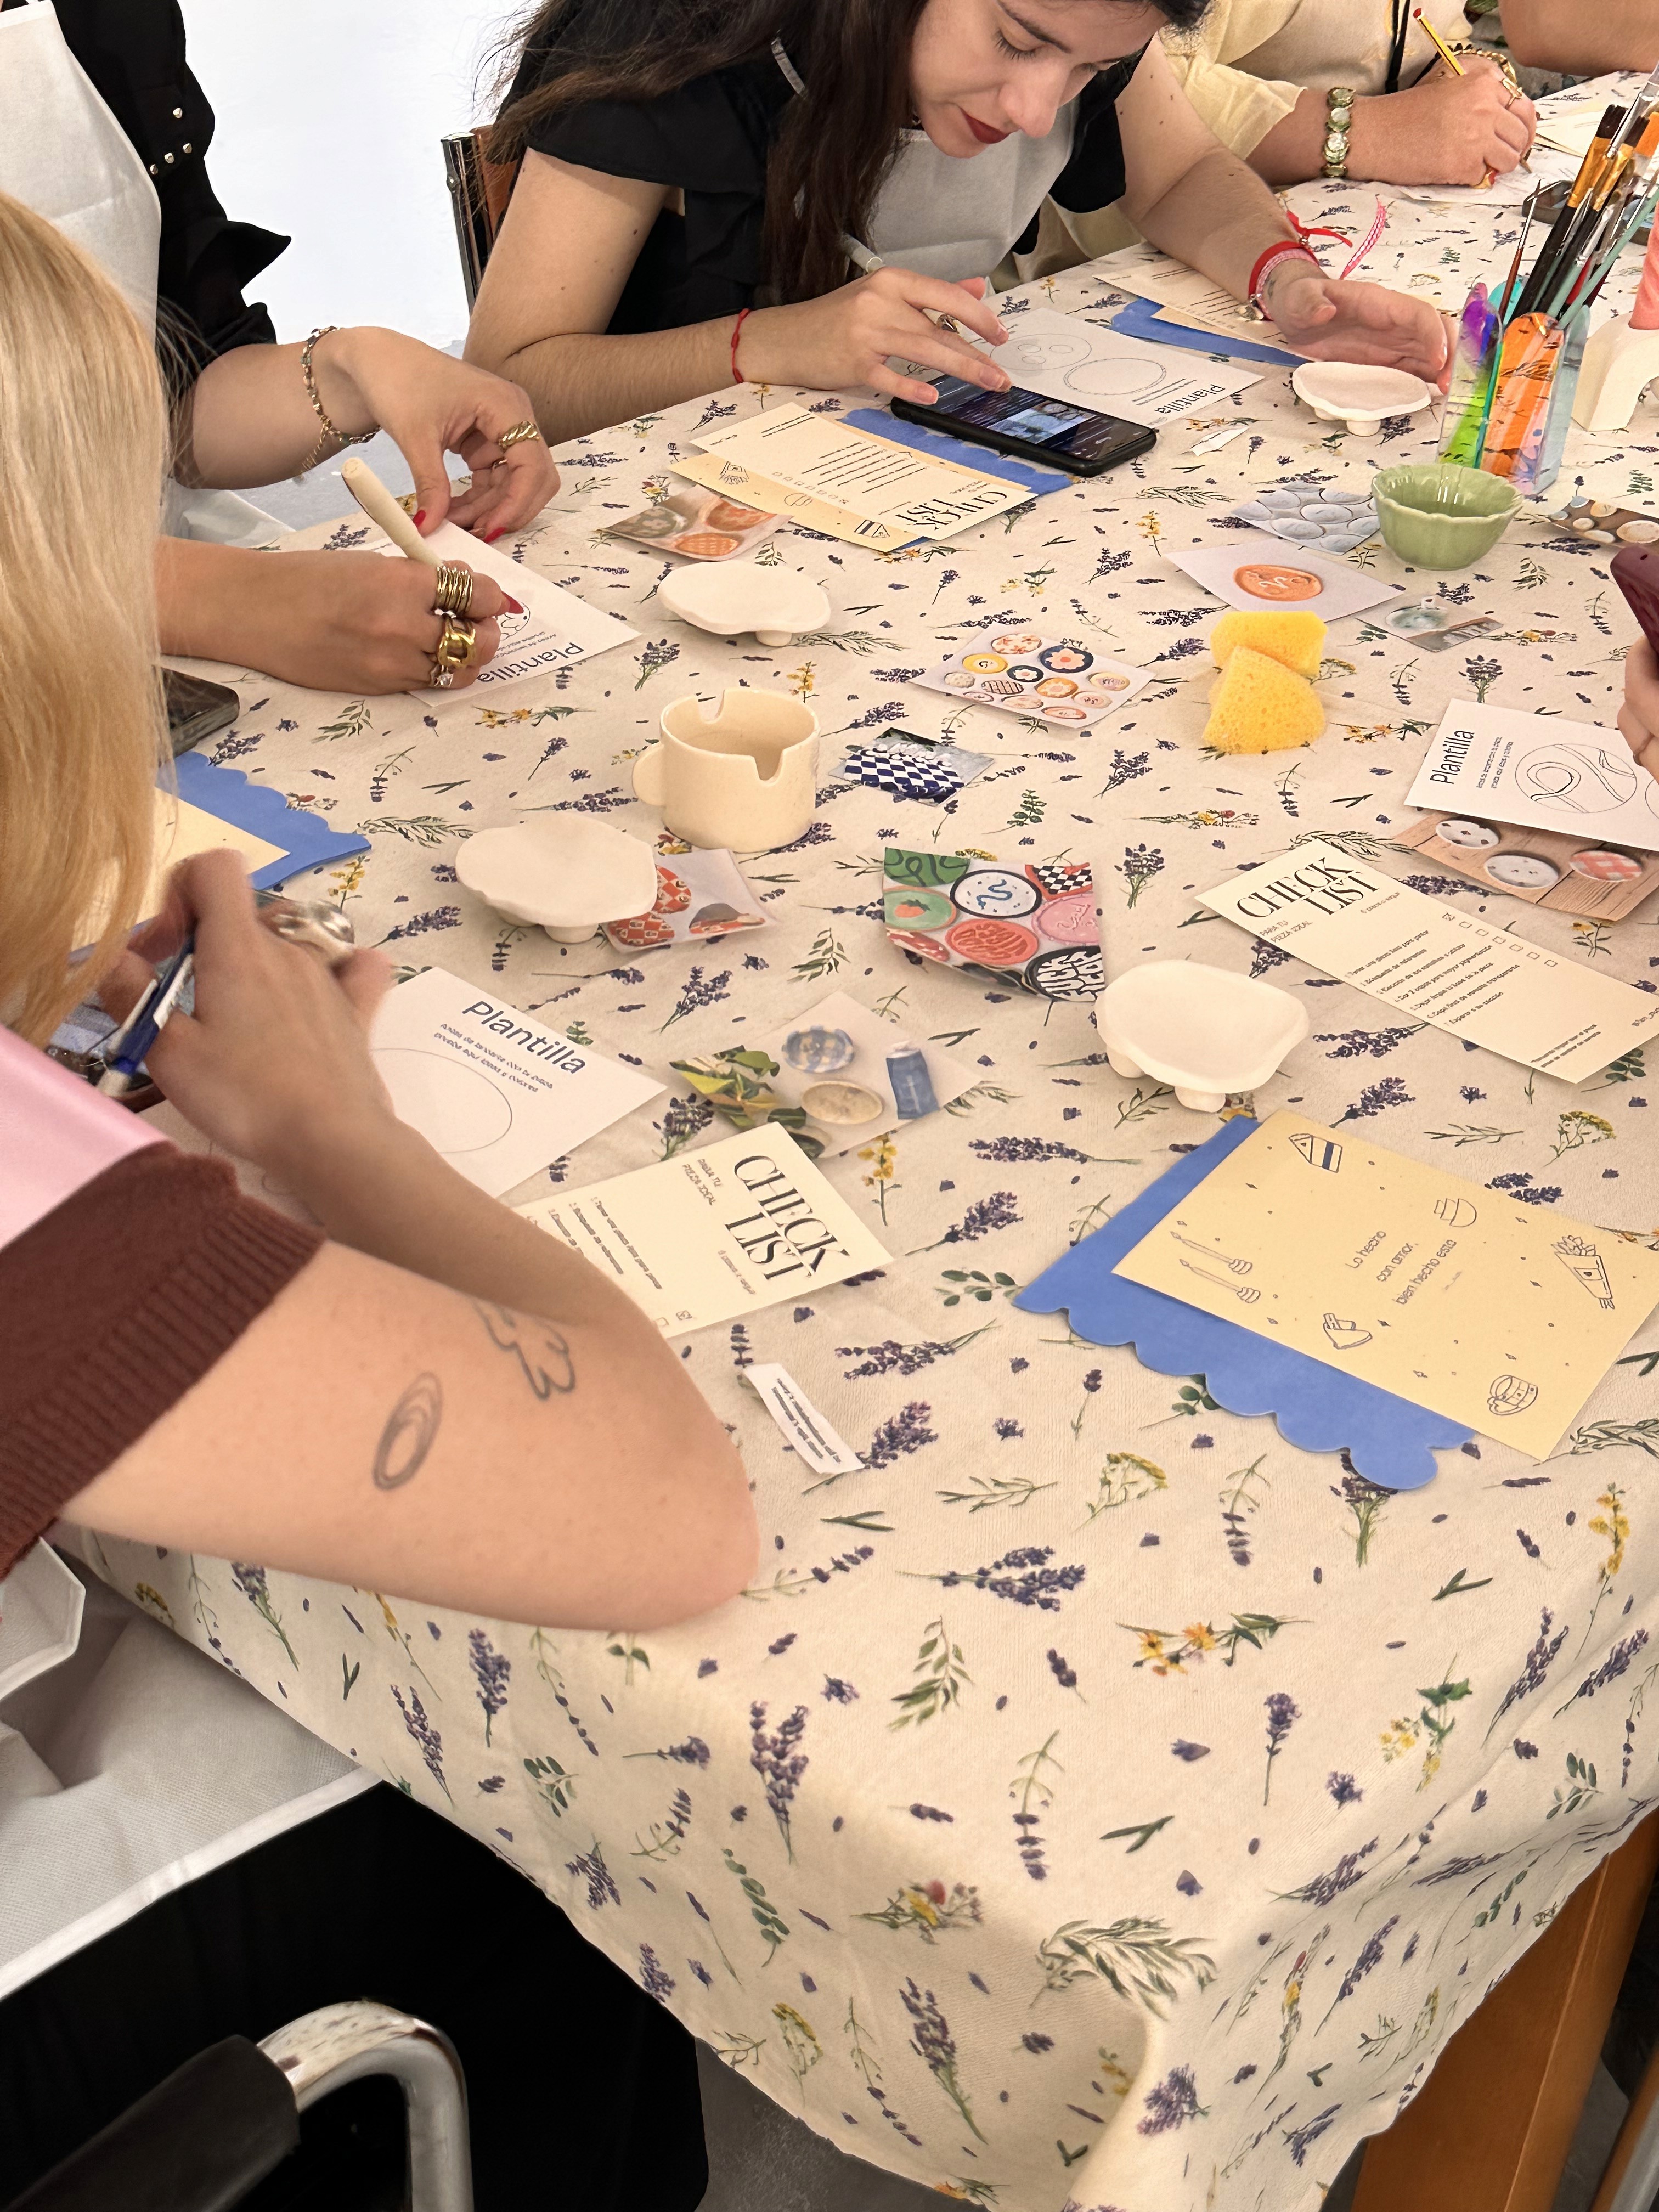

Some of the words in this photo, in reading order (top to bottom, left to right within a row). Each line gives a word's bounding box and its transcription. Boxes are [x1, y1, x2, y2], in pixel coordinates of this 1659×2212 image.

[1154, 384, 1226, 414] Plantilla
[895, 498, 954, 522] LIST
[906, 492, 1007, 531] CHECK
[477, 642, 584, 684] Plantilla
[1430, 730, 1475, 785] Plantilla
[1237, 857, 1354, 918] CHECK
[1301, 871, 1380, 915] LIST
[462, 1001, 586, 1074] Plantilla
[734, 1155, 850, 1273] CHECK
[724, 1211, 812, 1280] LIST
[1345, 1257, 1363, 1268] Lo
[1355, 1231, 1386, 1256] hecho
[1376, 1265, 1396, 1282] con
[1391, 1285, 1417, 1305] bien
[1409, 1258, 1440, 1285] hecho
